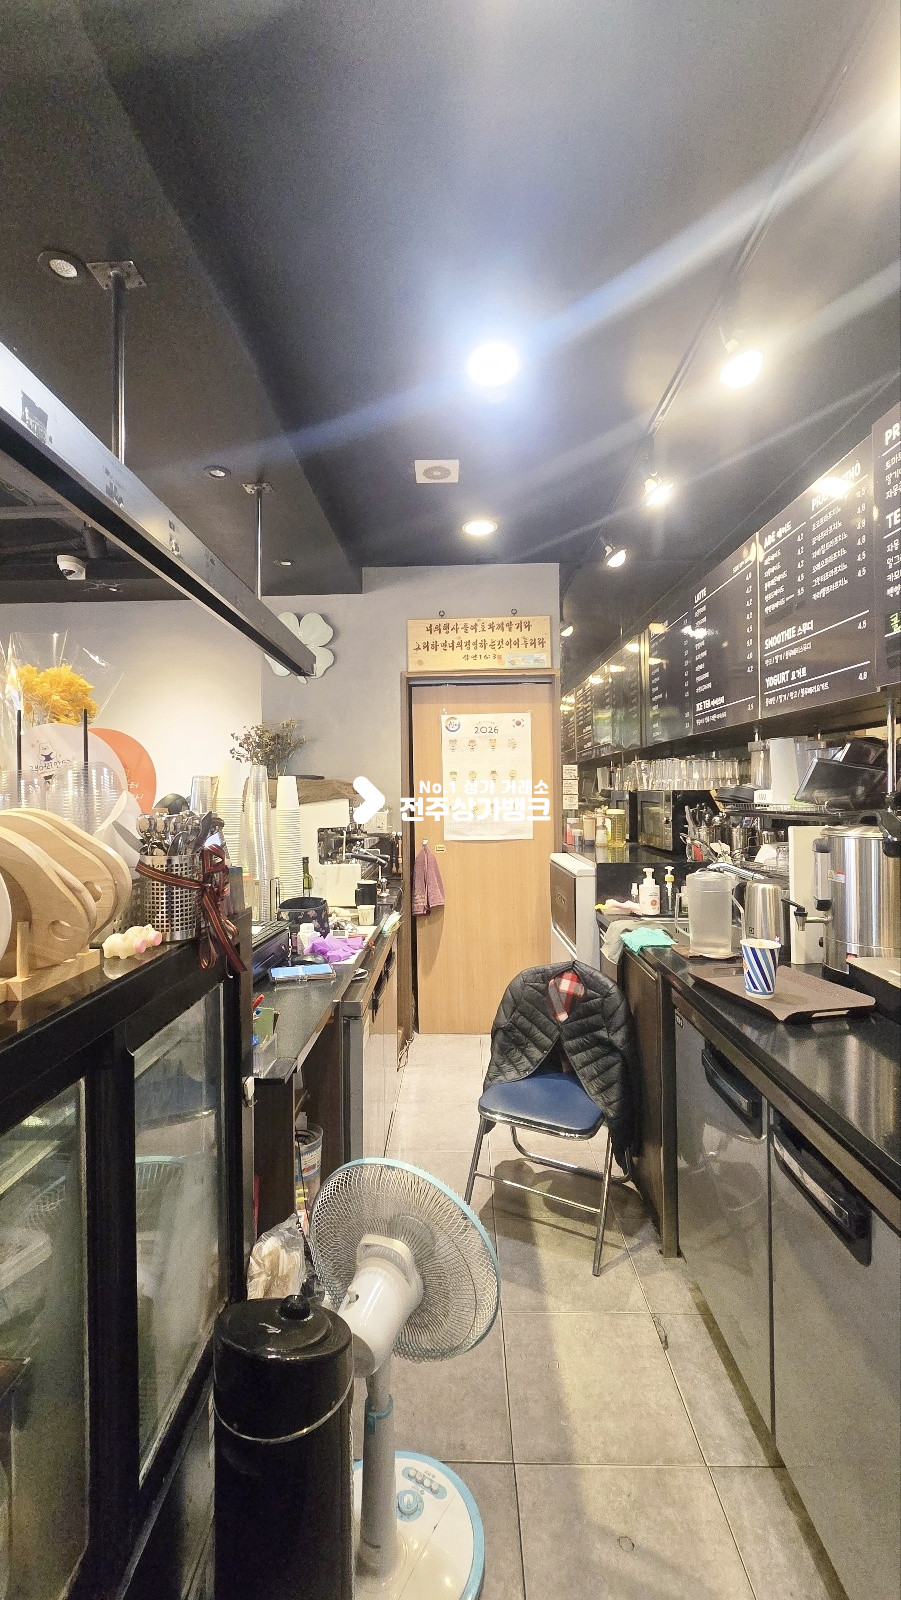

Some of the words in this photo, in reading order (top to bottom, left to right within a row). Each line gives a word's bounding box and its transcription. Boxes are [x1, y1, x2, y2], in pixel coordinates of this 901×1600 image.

[885, 468, 901, 486] 딸기
[885, 480, 901, 499] 자몽
[886, 554, 901, 570] 얼그
[764, 626, 796, 650] SMOOTHIE
[765, 669, 791, 689] YOGURT
[474, 726, 499, 734] 2026
